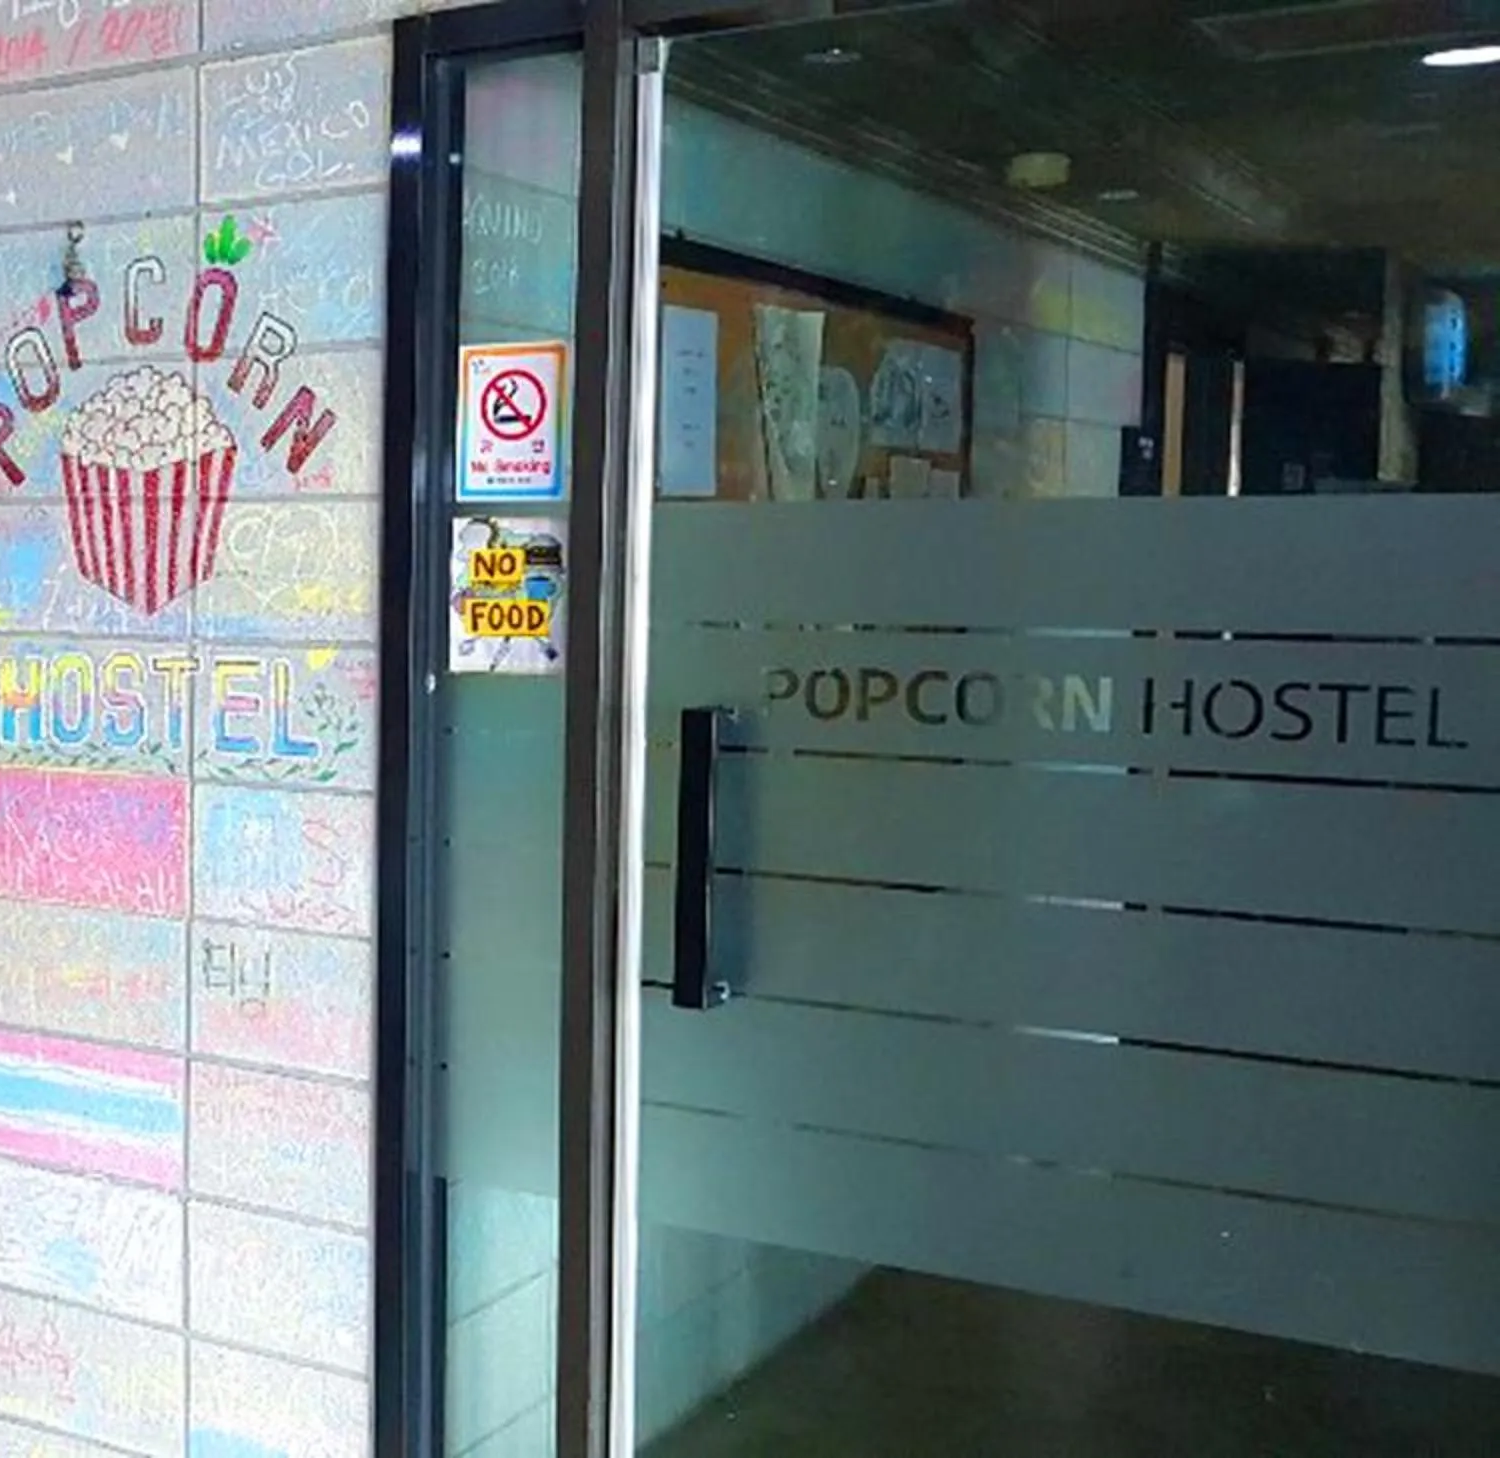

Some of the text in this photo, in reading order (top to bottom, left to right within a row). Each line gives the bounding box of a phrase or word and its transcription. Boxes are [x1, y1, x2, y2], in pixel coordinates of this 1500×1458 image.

[214, 98, 370, 170] MEXICO
[473, 552, 517, 579] NO
[470, 602, 545, 632] FOOD
[1141, 676, 1469, 750] HOSTEL
